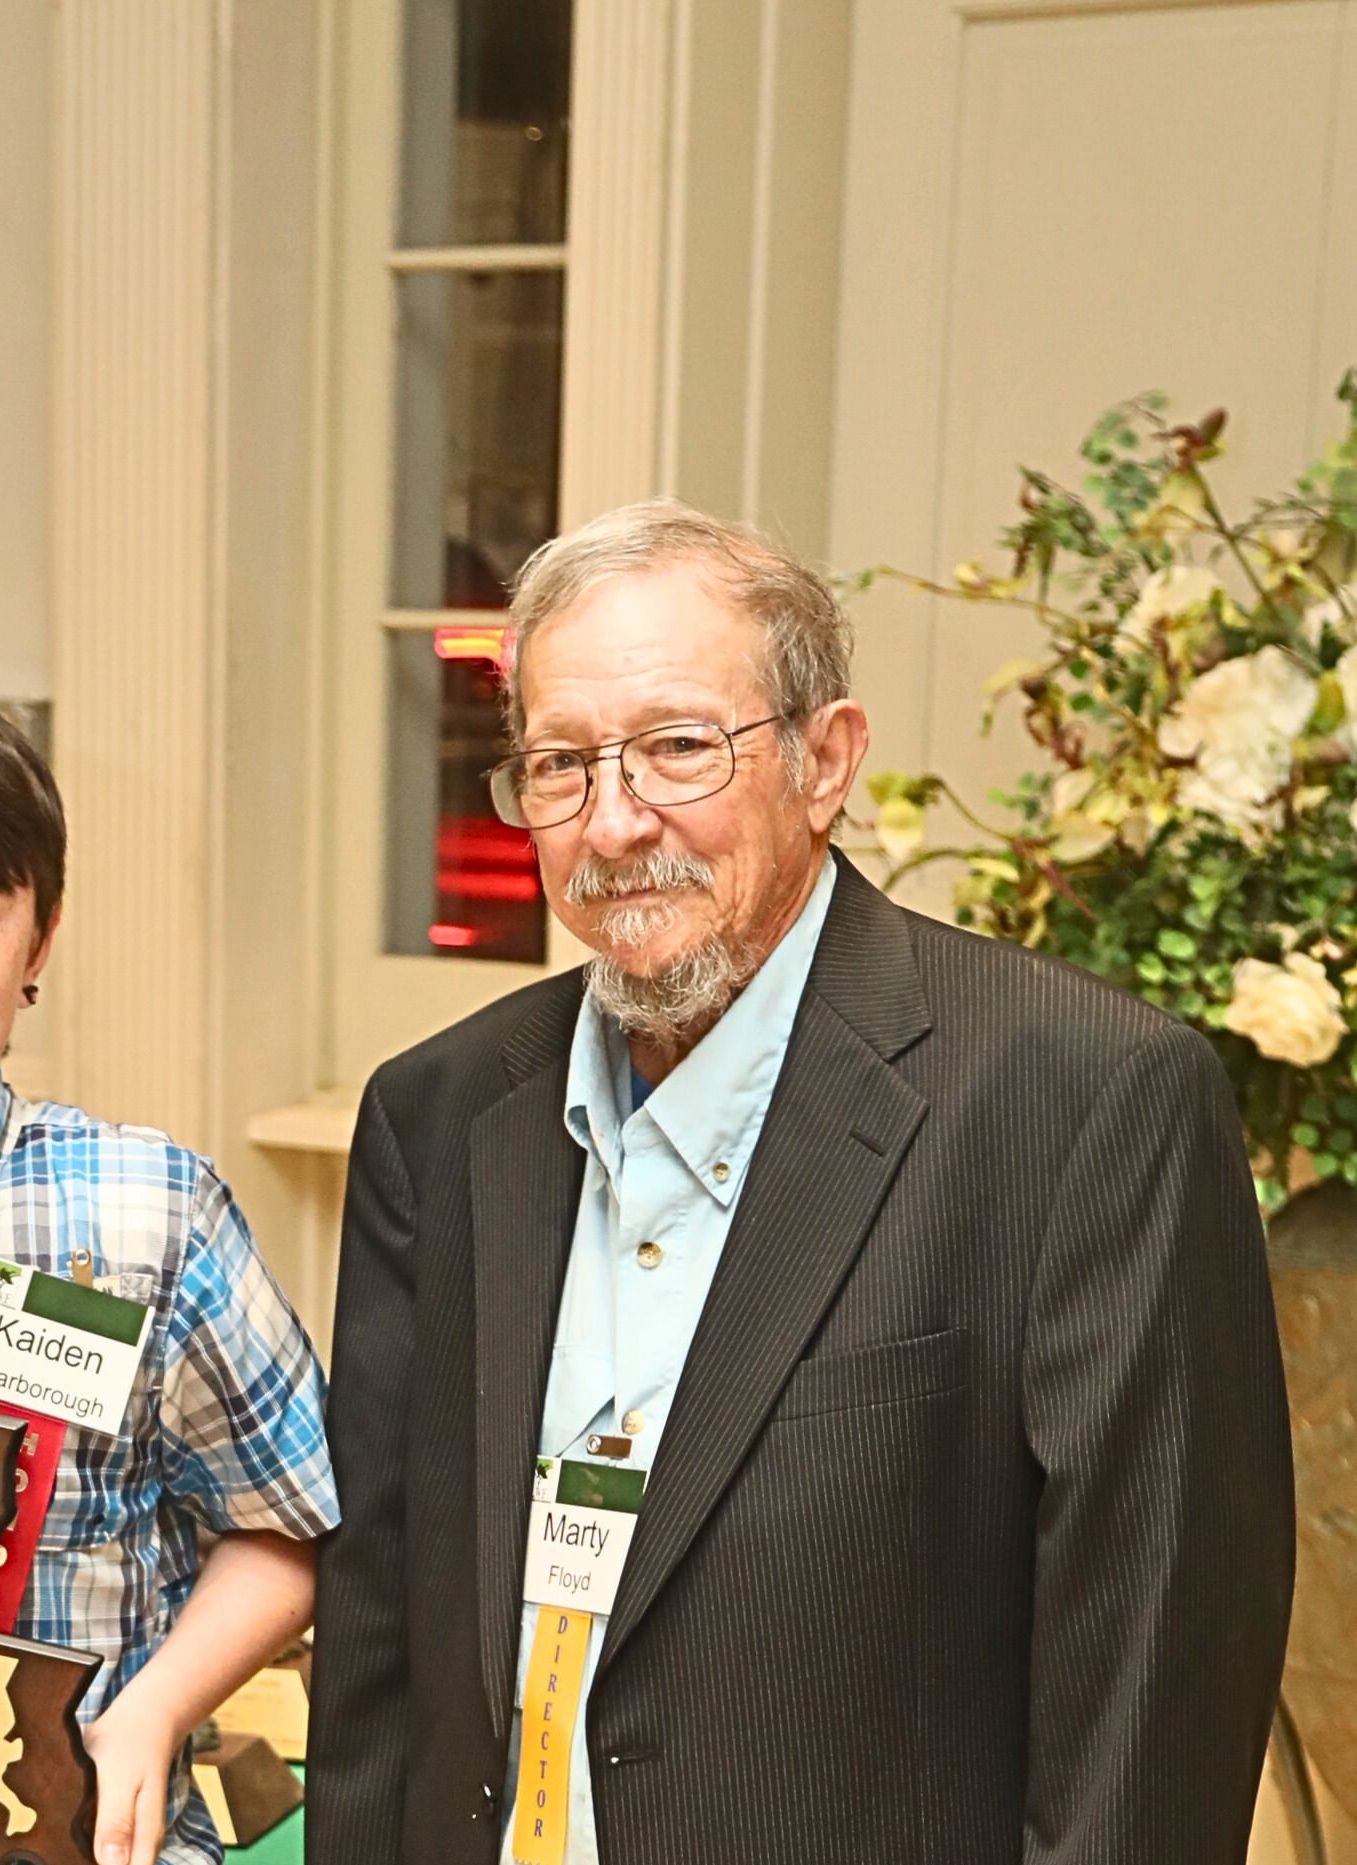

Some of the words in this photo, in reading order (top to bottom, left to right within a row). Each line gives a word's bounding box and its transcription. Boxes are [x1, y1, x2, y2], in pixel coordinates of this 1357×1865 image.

[544, 1511, 610, 1557] Marty
[548, 1565, 592, 1594] Floyd
[534, 1615, 568, 1837] DIRECTOR
